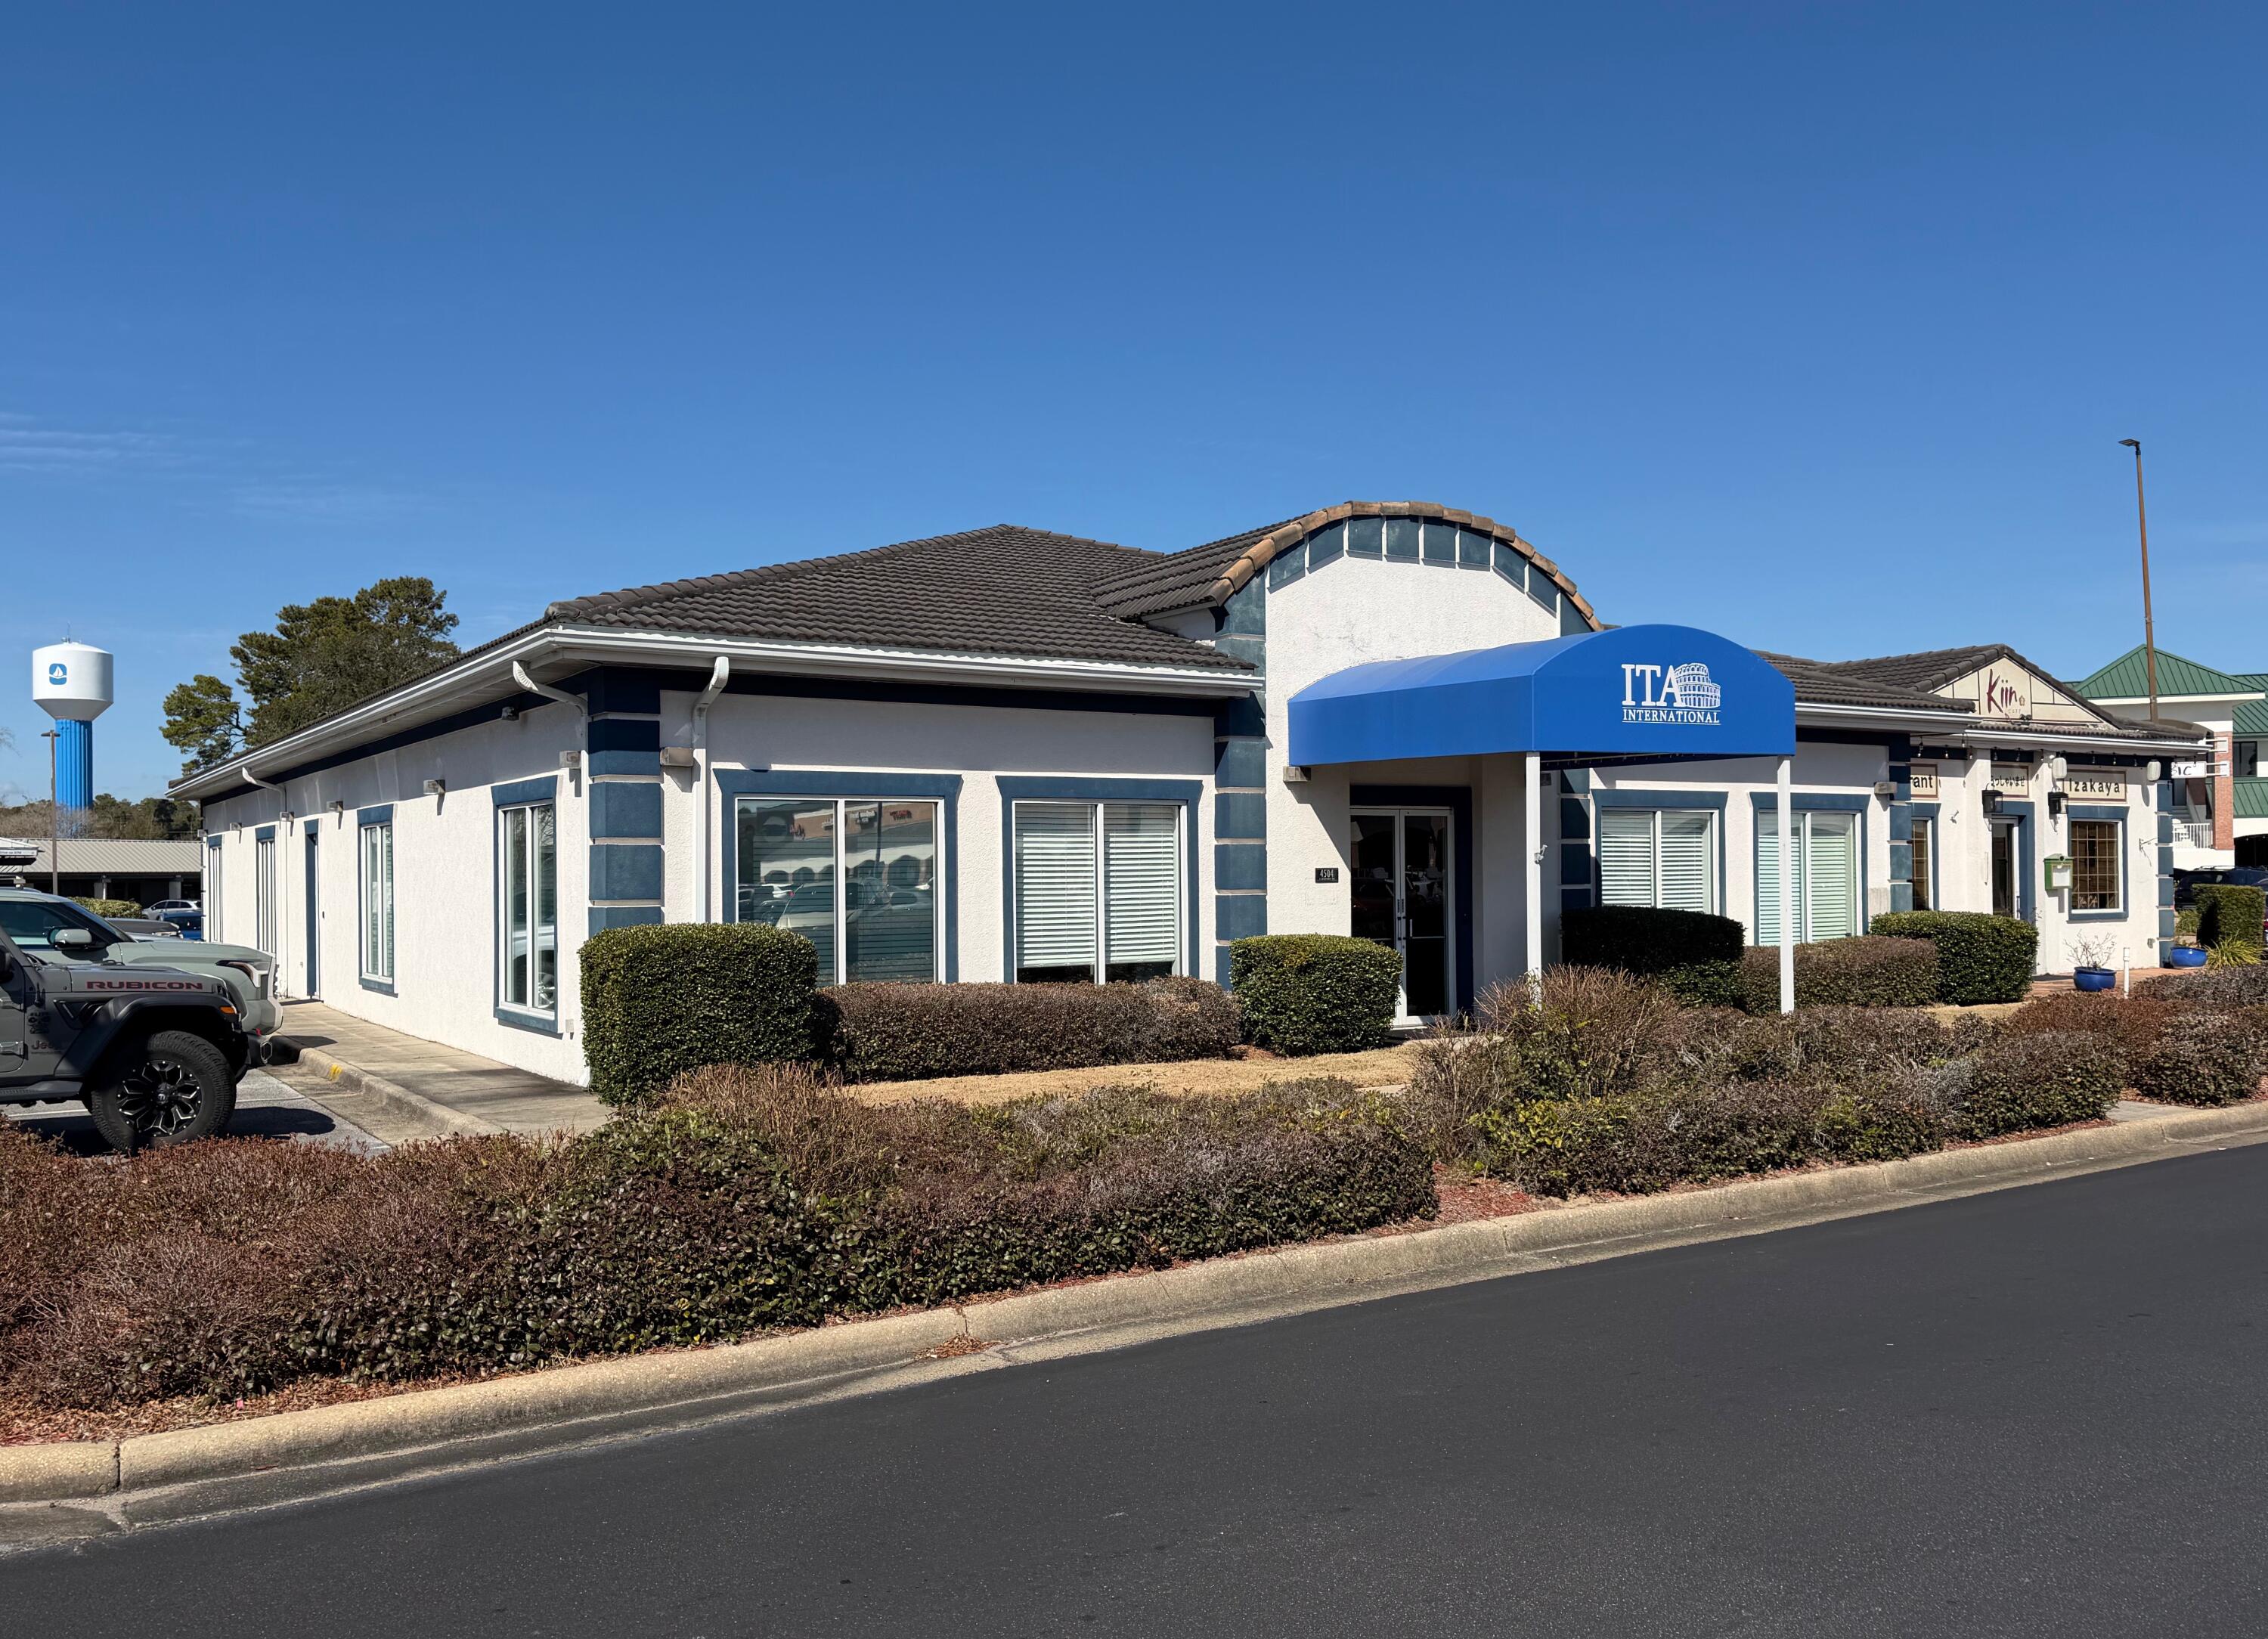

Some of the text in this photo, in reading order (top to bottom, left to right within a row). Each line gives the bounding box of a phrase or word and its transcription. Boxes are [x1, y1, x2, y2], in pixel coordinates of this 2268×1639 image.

[1621, 664, 1684, 707] ITA
[1986, 668, 2018, 714] Kiin
[1623, 709, 1720, 723] INTERNATIONAL
[2068, 778, 2121, 796] Izakaya
[1319, 869, 1334, 878] 4504
[86, 981, 203, 990] RUBICON
